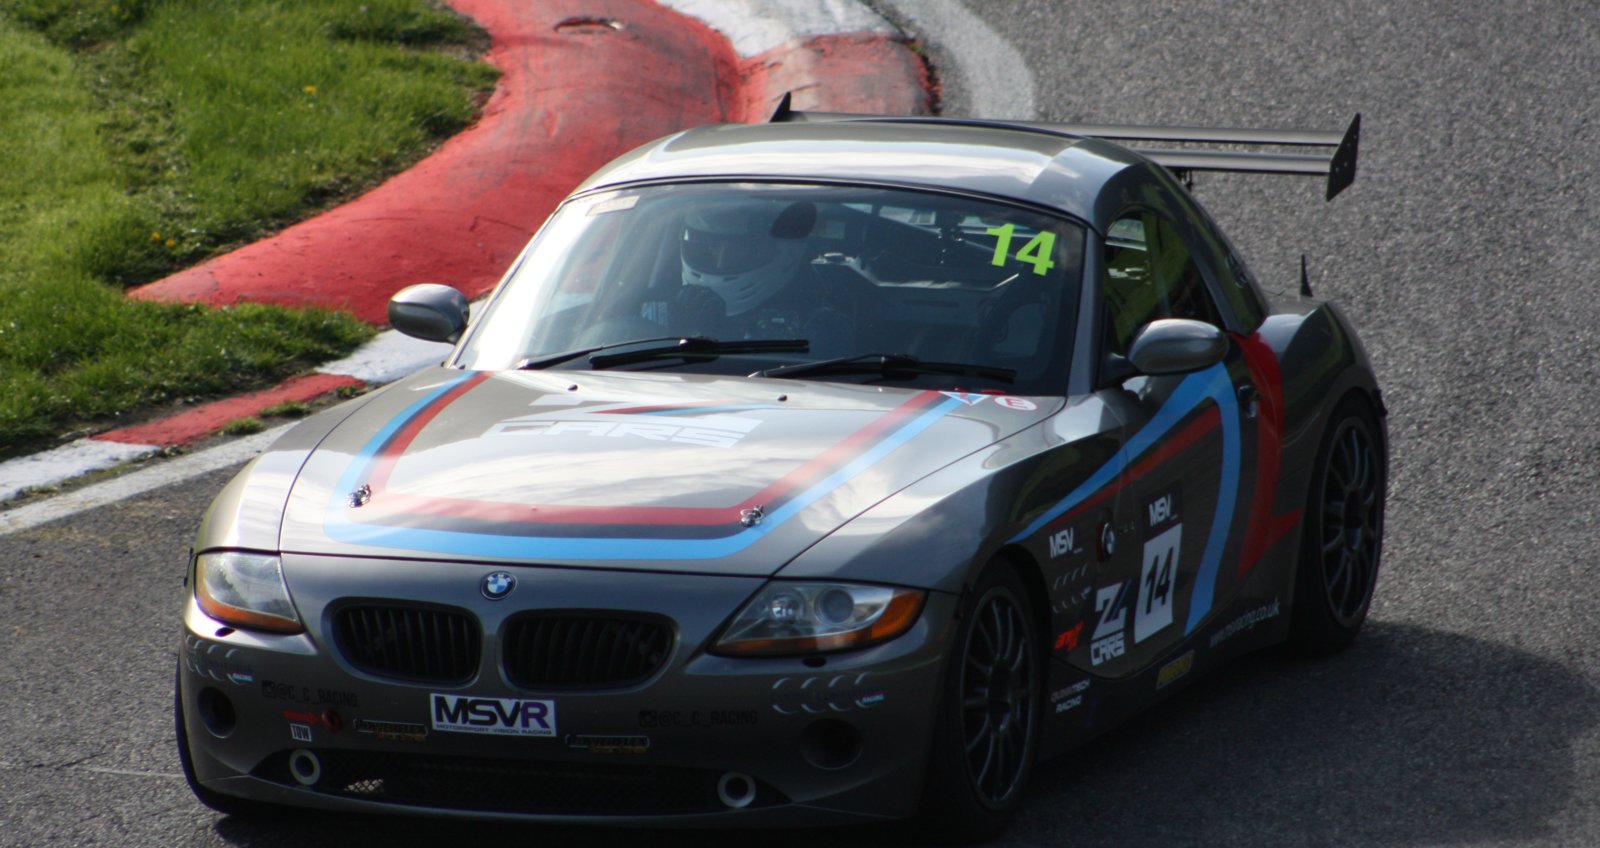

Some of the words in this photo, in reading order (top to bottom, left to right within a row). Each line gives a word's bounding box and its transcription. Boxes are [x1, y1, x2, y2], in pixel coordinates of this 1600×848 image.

[986, 222, 1056, 276] 14
[480, 421, 747, 449] CARS
[1149, 493, 1172, 526] MSV
[1049, 527, 1074, 558] MSV
[1144, 546, 1175, 615] 14
[1090, 631, 1126, 667] CARS
[434, 695, 551, 729] MSVR
[292, 724, 310, 740] TOW
[436, 723, 489, 732] MOTORSPORT
[521, 728, 552, 736] RACING
